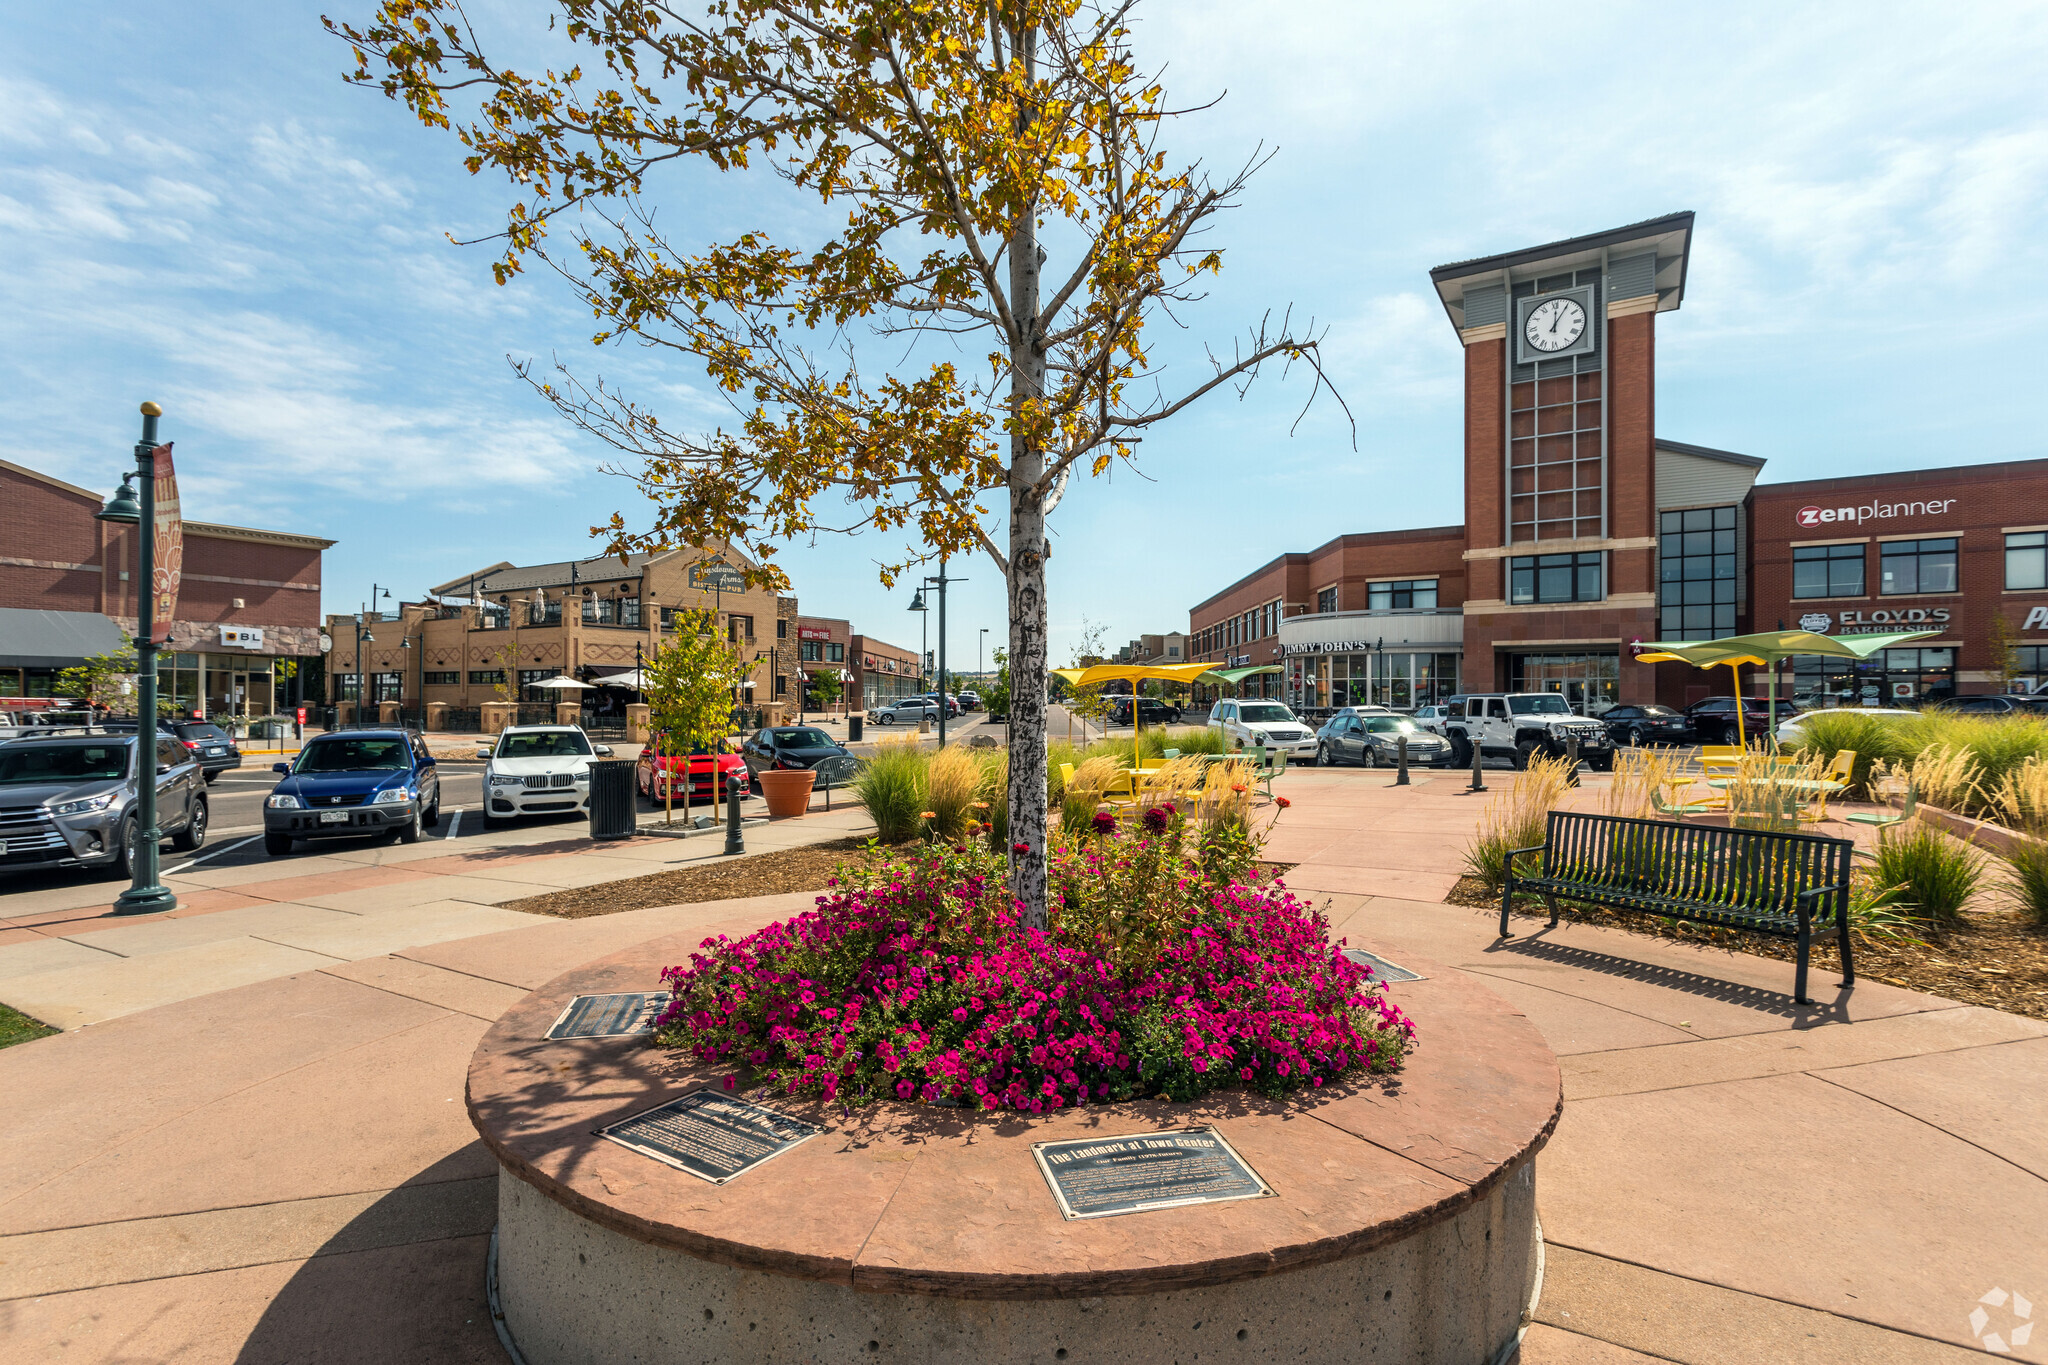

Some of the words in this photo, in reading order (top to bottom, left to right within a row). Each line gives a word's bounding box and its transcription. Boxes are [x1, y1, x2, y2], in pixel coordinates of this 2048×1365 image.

[726, 585, 742, 593] PUB
[1839, 608, 1950, 624] FLOYD'S
[1284, 643, 1316, 655] JIMMY
[1319, 640, 1367, 654] JOHN'S
[1047, 1152, 1072, 1165] The
[1069, 1142, 1128, 1160] Landmark
[1127, 1140, 1143, 1150] at
[1142, 1139, 1174, 1149] Town
[1174, 1138, 1216, 1148] Center
